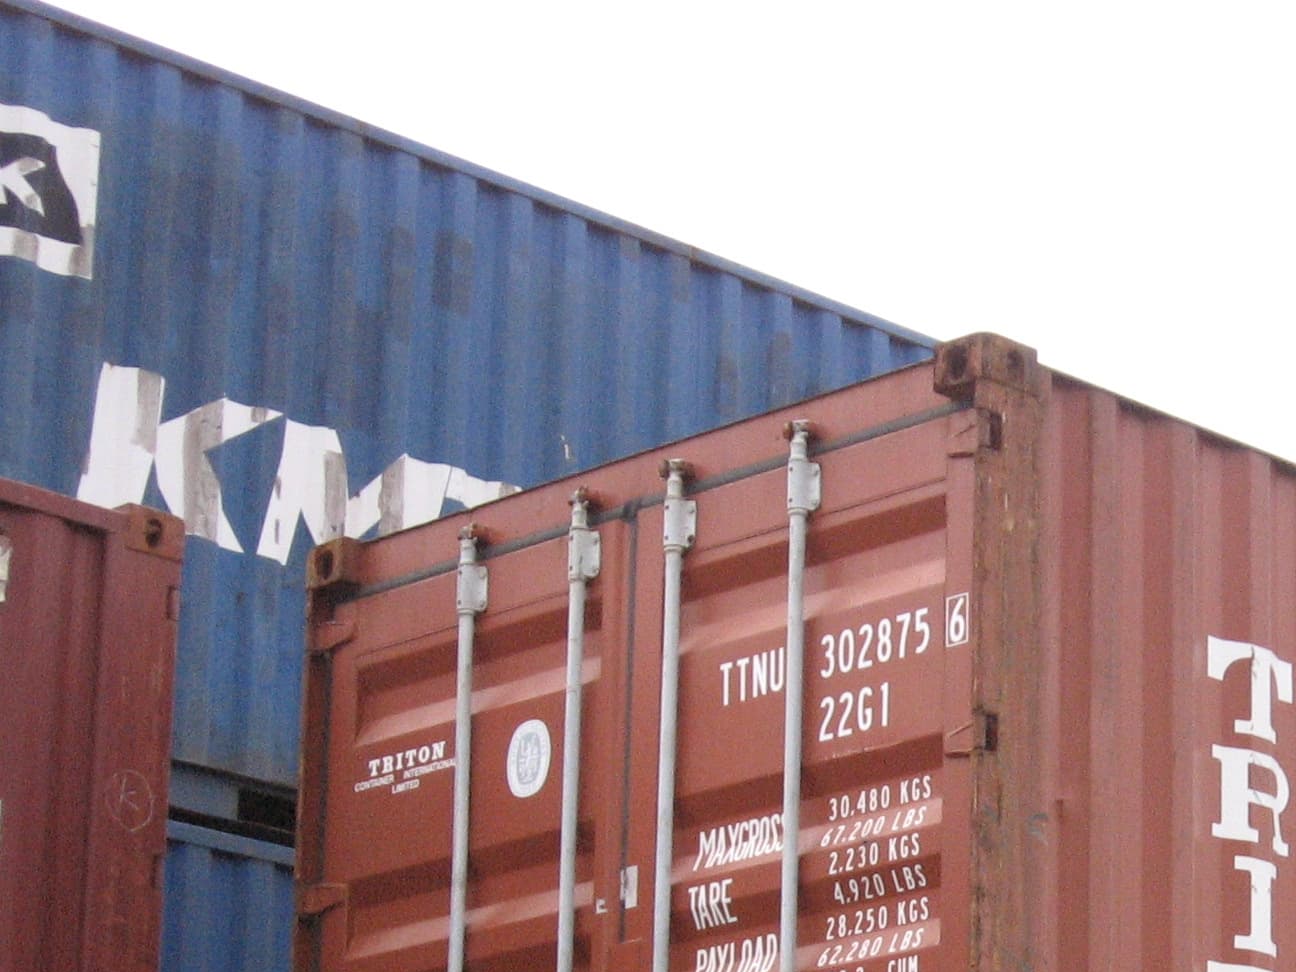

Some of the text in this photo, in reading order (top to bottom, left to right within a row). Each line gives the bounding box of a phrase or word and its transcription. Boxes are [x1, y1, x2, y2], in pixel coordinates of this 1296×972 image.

[720, 596, 965, 706] TTNU 302875 6
[818, 682, 889, 742] 22G1
[368, 740, 446, 777] TRITON
[900, 775, 932, 798] KGS
[891, 805, 927, 830] LBS
[688, 878, 738, 931] TARE
[888, 832, 920, 858] KGS
[891, 863, 927, 893] LBS
[897, 896, 930, 926] KGS
[888, 927, 924, 953] LBS
